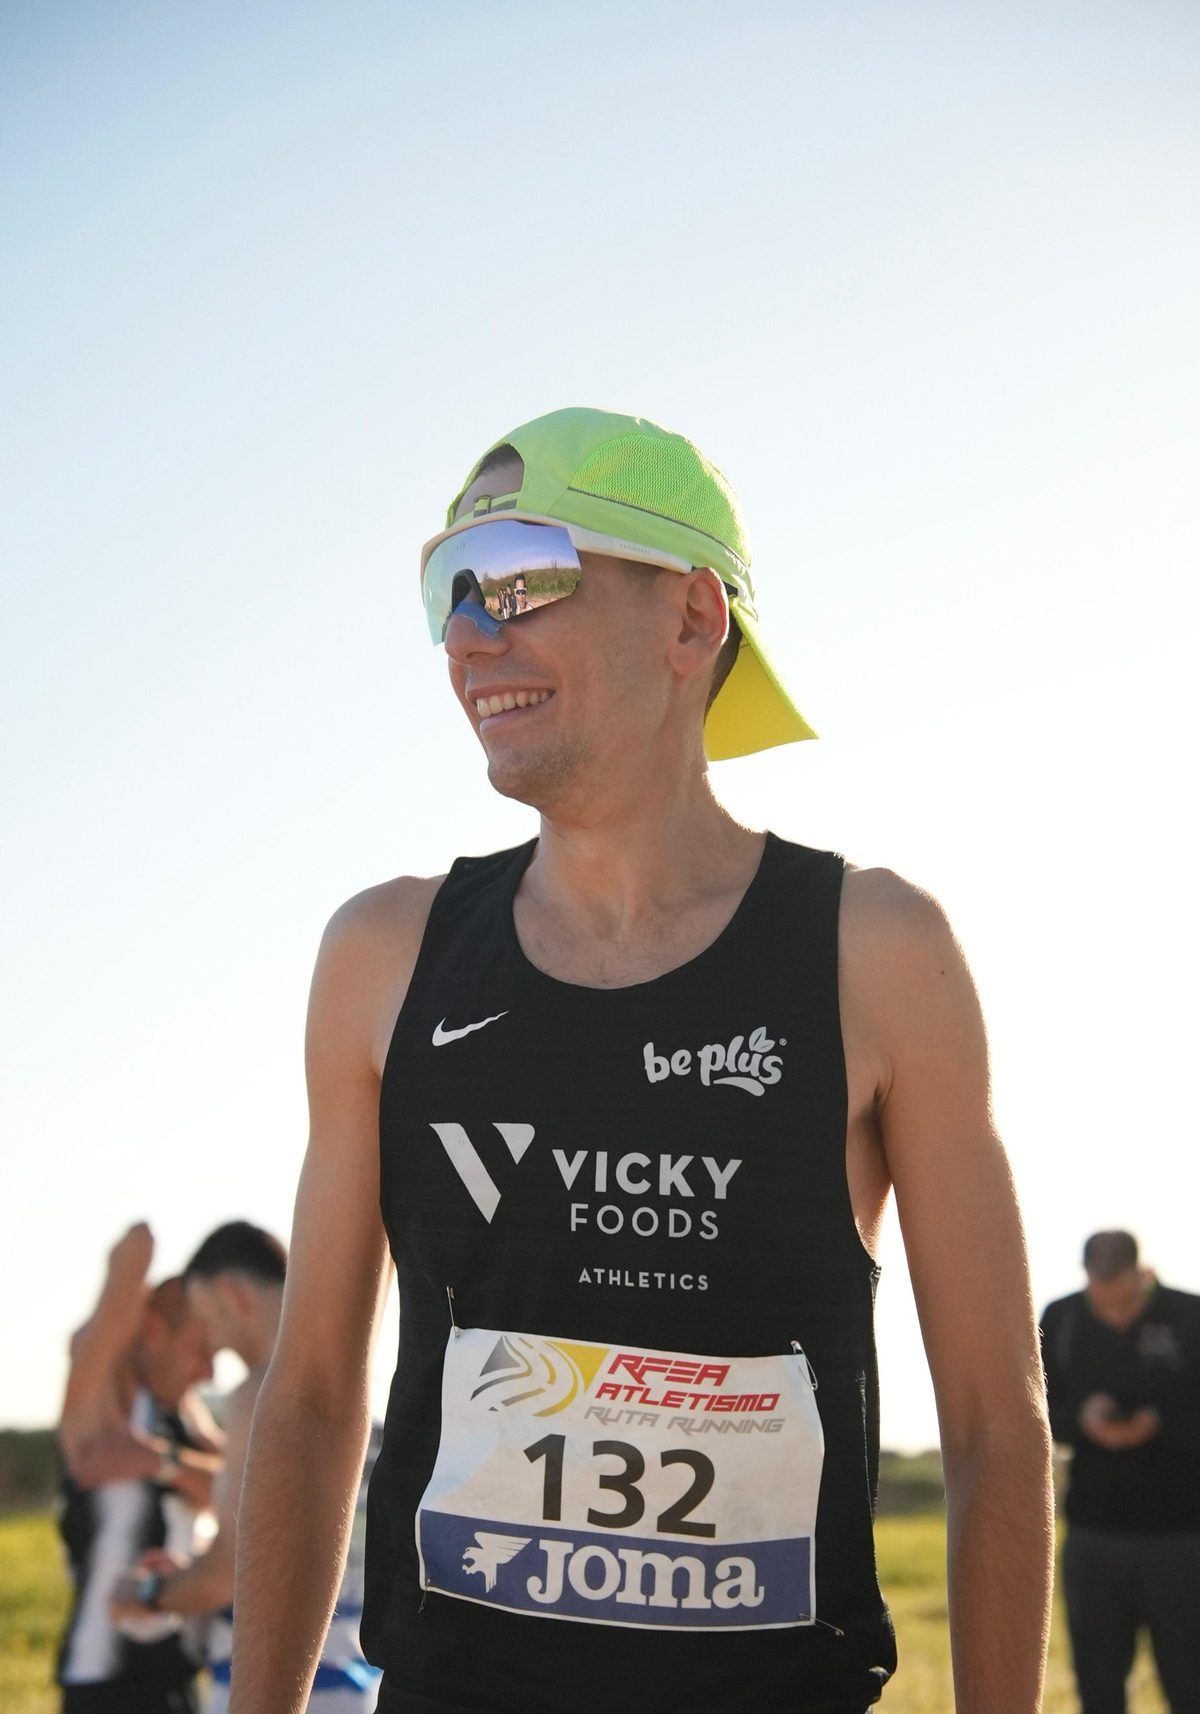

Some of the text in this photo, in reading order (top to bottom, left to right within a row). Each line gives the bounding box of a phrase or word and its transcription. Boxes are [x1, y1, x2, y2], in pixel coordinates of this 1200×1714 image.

[643, 1035, 783, 1087] be plus
[552, 1149, 743, 1200] VICKY
[570, 1203, 719, 1240] FOODS
[578, 1267, 709, 1291] ATHLETICS
[607, 1353, 731, 1387] RFEA
[595, 1382, 781, 1413] ATLETISMO
[583, 1405, 786, 1437] RUTA RUNNING
[523, 1433, 716, 1538] 132
